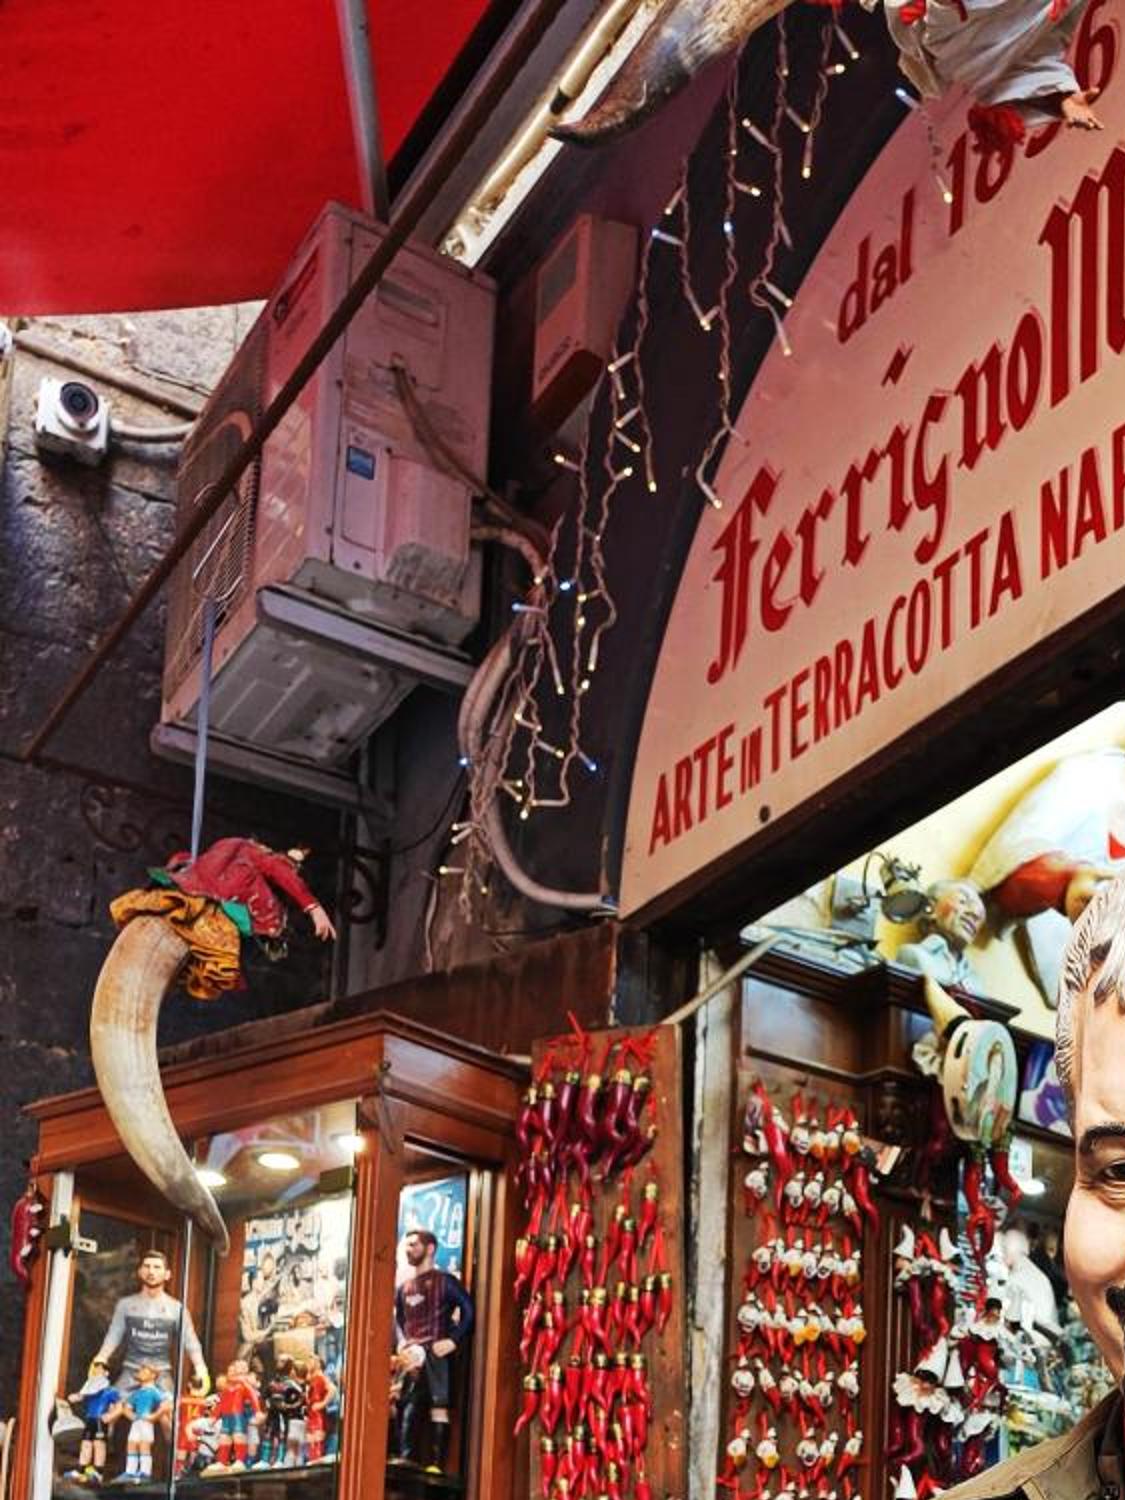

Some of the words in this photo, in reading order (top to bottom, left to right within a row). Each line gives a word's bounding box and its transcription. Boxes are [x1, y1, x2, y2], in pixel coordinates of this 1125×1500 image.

[838, 187, 914, 344] dal
[649, 722, 735, 857] ARTE
[763, 509, 1023, 773] TERRACOTTA
